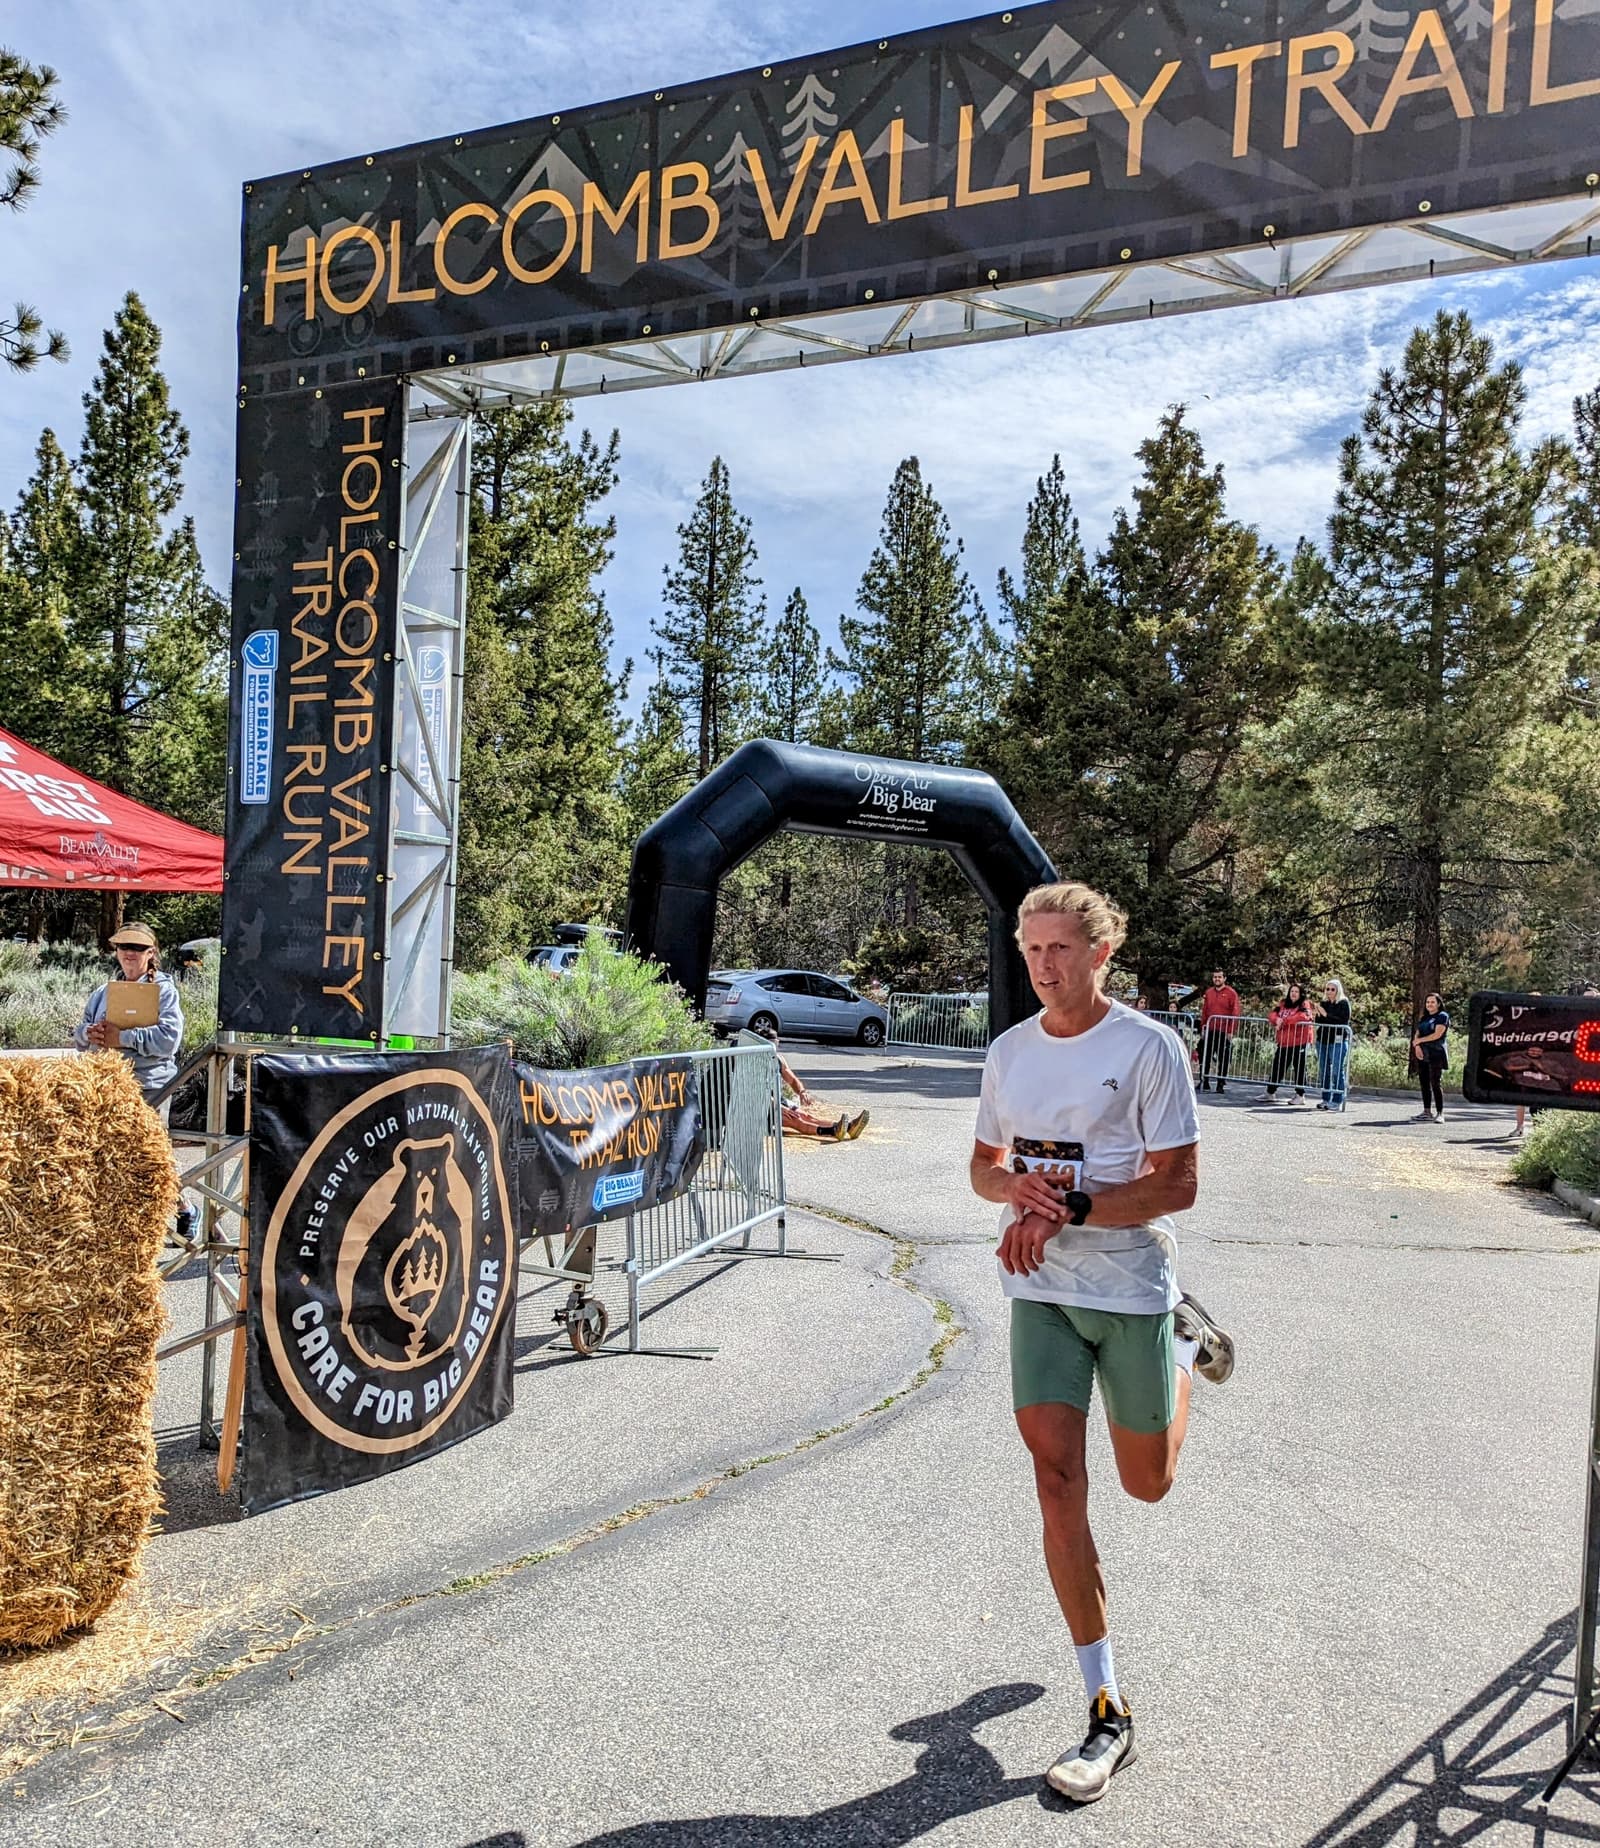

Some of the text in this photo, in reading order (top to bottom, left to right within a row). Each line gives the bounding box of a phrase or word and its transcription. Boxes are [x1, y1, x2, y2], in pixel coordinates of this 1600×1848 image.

[264, 0, 1600, 325] HOLCOMB VALLEY TRAIL
[255, 674, 270, 795] BIG BEAR LAKE
[280, 546, 334, 875] TRAIL RUN
[322, 407, 385, 1014] HOLCOMB VALLEY
[26, 794, 113, 825] AID
[855, 762, 933, 804] Open Air
[872, 785, 936, 813] Big Bear
[519, 1079, 639, 1125] HOLCOMB
[628, 1116, 660, 1159] RUN
[299, 1103, 491, 1257] PRESERVE OUR NATURAL PLAYGROUND
[292, 1259, 500, 1424] CARE FOR BIG BEAR
